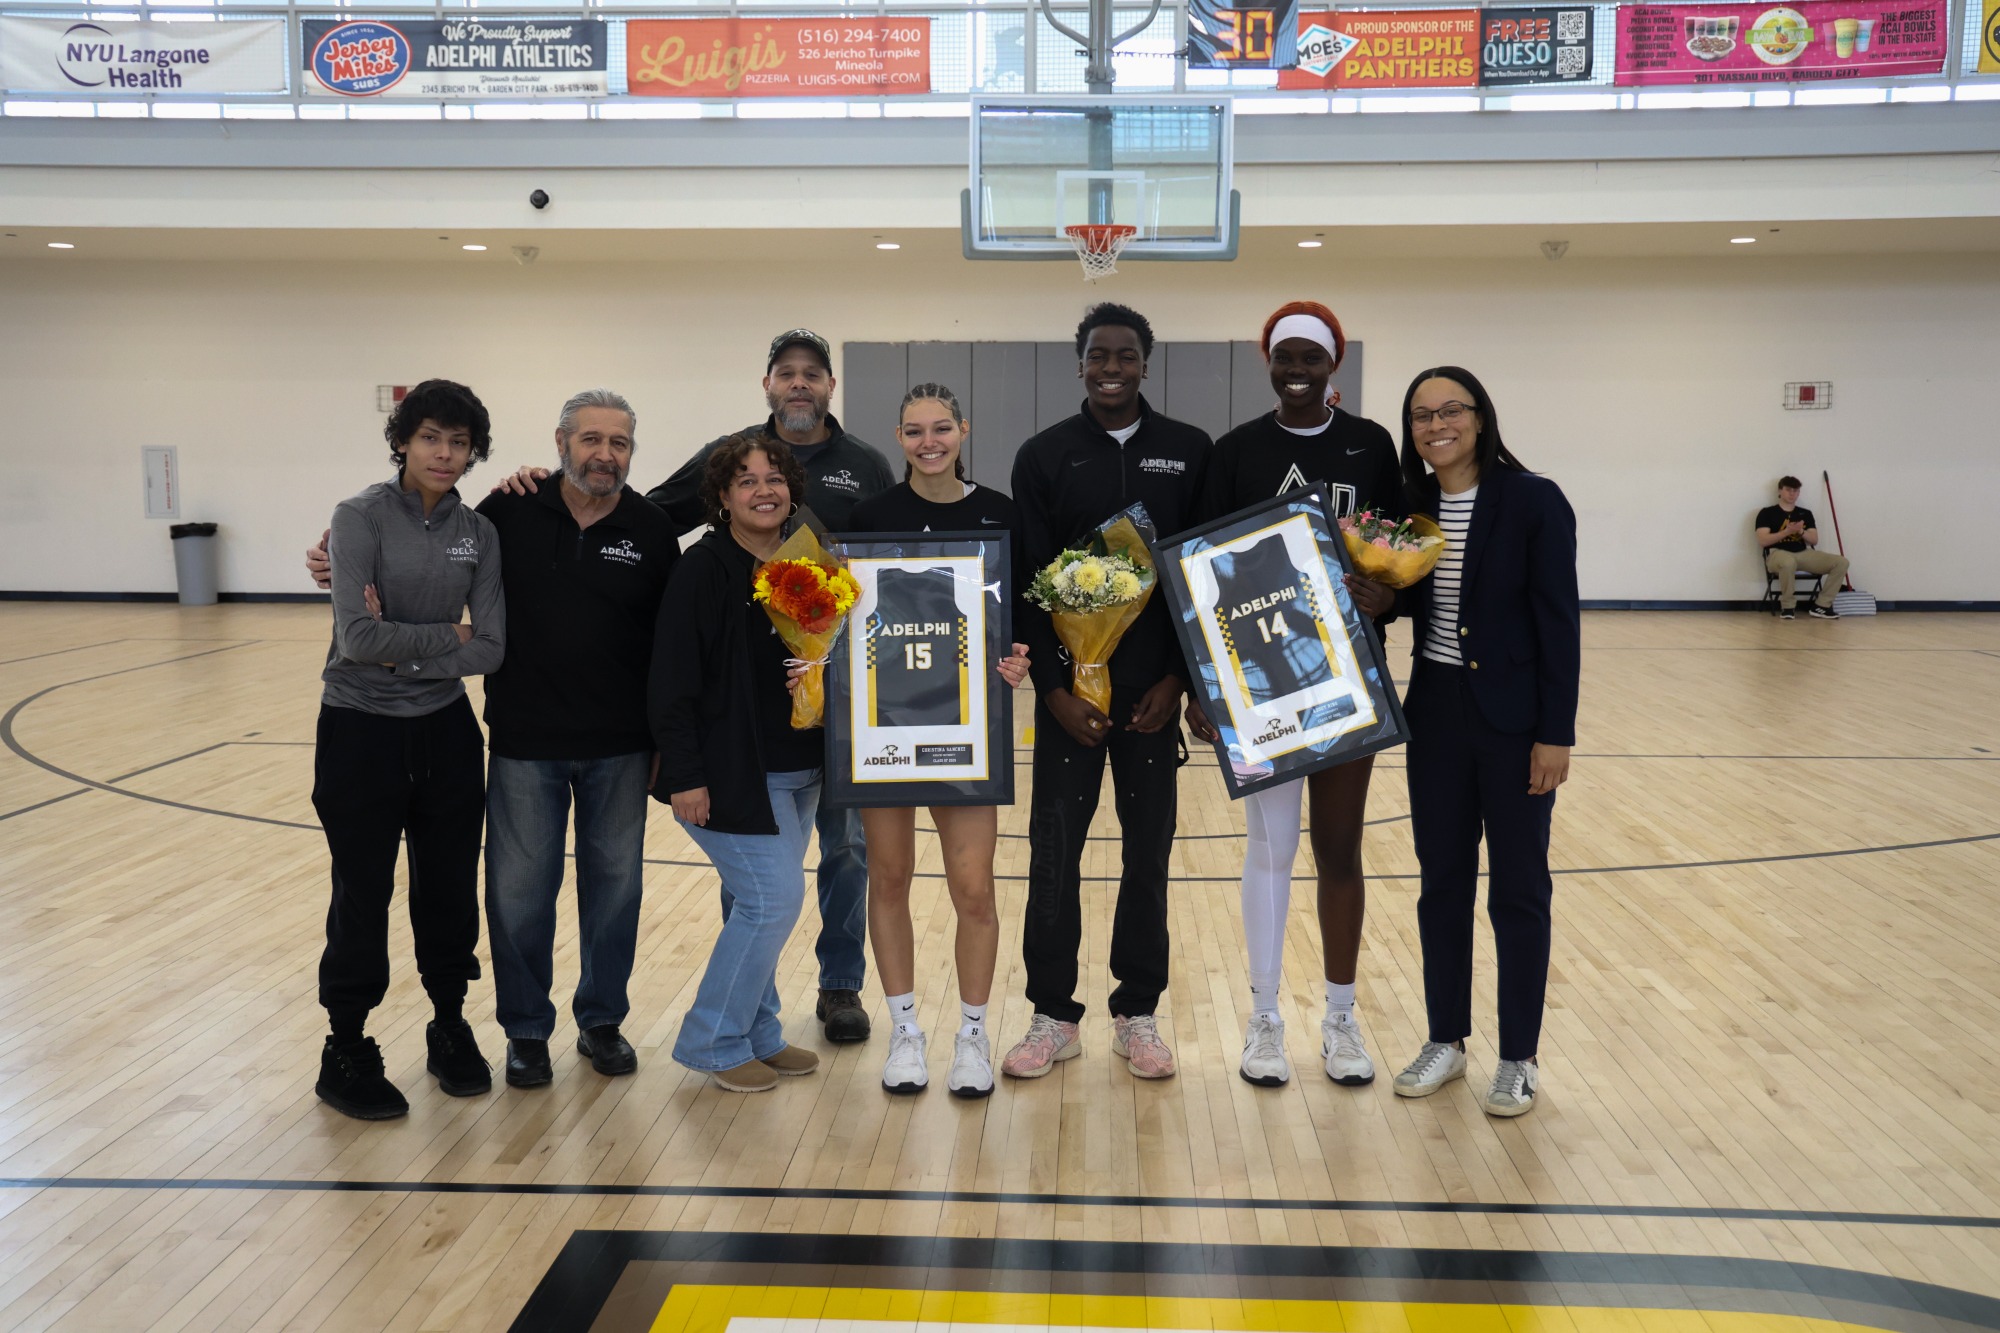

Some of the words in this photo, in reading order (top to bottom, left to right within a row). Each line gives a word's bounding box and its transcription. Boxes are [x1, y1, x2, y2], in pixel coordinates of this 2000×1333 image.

[1881, 12, 1898, 21] THE
[1899, 10, 1936, 21] BIGGEST
[442, 22, 466, 42] We
[468, 24, 523, 45] Proudly
[523, 25, 573, 43] Support
[1345, 23, 1353, 34] A
[1354, 22, 1389, 34] PROUD
[1391, 21, 1440, 33] SPONSOR
[1442, 21, 1453, 32] OF
[1455, 20, 1474, 32] THE
[1486, 18, 1550, 42] FREE
[1880, 22, 1901, 34] ACAI
[1904, 21, 1936, 32] BOWLS
[798, 29, 839, 44] (516)
[843, 28, 921, 42] 294-7400
[1213, 10, 1274, 60] 30
[1879, 36, 1886, 45] IN
[1888, 35, 1900, 44] THE
[1902, 32, 1936, 43] TRI-STATE
[325, 38, 396, 61] Jersey
[798, 49, 820, 59] 526
[822, 48, 866, 59] Jericho
[868, 47, 920, 60] Turnpike
[1355, 36, 1464, 57] ADELPHI
[66, 42, 113, 62] NYU
[118, 44, 210, 68] Langone
[426, 45, 496, 67] ADELPHI
[502, 45, 592, 67] ATHLETICS
[636, 24, 787, 91] Luigi's
[1484, 42, 1551, 67] QUESO
[835, 60, 884, 70] Mineola
[1345, 58, 1474, 79] PANTHERS
[107, 67, 182, 88] Health
[746, 74, 791, 83] PIZZERIA
[798, 72, 921, 86] LUIGIS-ONLINE.COM
[1484, 70, 1498, 78] When
[1507, 69, 1529, 77] Download
[1530, 69, 1538, 77] Our
[1539, 69, 1549, 77] App
[1695, 73, 1713, 82] 301
[1717, 73, 1758, 81] NASSAU
[1792, 70, 1832, 79] GARDEN
[1836, 68, 1859, 77] CITY
[352, 78, 380, 90] SUBS
[421, 85, 439, 93] 2345
[440, 85, 465, 93] JERICHO
[487, 85, 513, 93] GARDEN
[514, 85, 530, 93] CITY
[531, 84, 548, 93] PARK
[1139, 458, 1185, 471] ADELPHI
[1143, 467, 1181, 475] BASKETBALL
[821, 475, 860, 489] ADELPHI
[825, 483, 856, 493] BASKETBALL
[600, 546, 642, 561] ADELPHI
[604, 556, 636, 566] BASKETBALL
[1231, 586, 1297, 621] ADELPHI
[880, 622, 950, 637] ADELPHI
[1256, 611, 1289, 644] 14
[904, 643, 932, 670] 15
[1252, 725, 1297, 746] ADELPHI
[863, 757, 910, 766] ADELPHI
